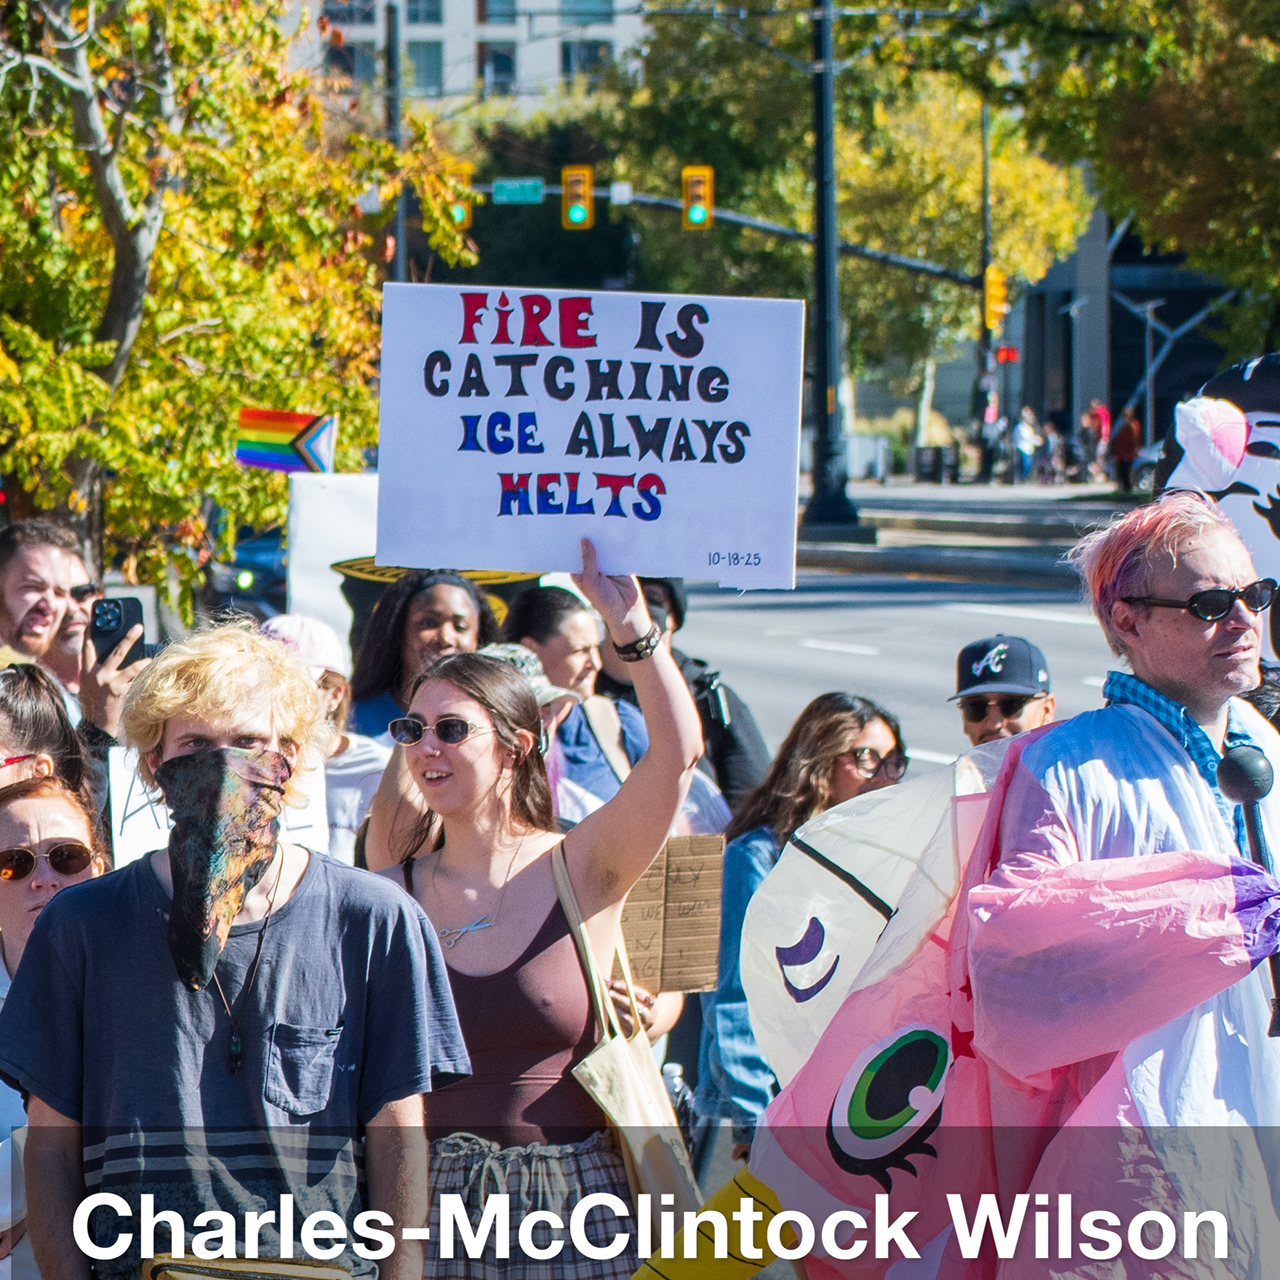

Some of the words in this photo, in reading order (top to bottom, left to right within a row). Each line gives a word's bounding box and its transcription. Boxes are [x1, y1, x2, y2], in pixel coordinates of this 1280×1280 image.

[634, 301, 709, 358] IS
[423, 350, 730, 403] CATCHING
[458, 411, 544, 454] ICE
[565, 411, 751, 463] ALWAYS
[497, 472, 666, 521] MELTS
[707, 551, 762, 567] 10-18-25
